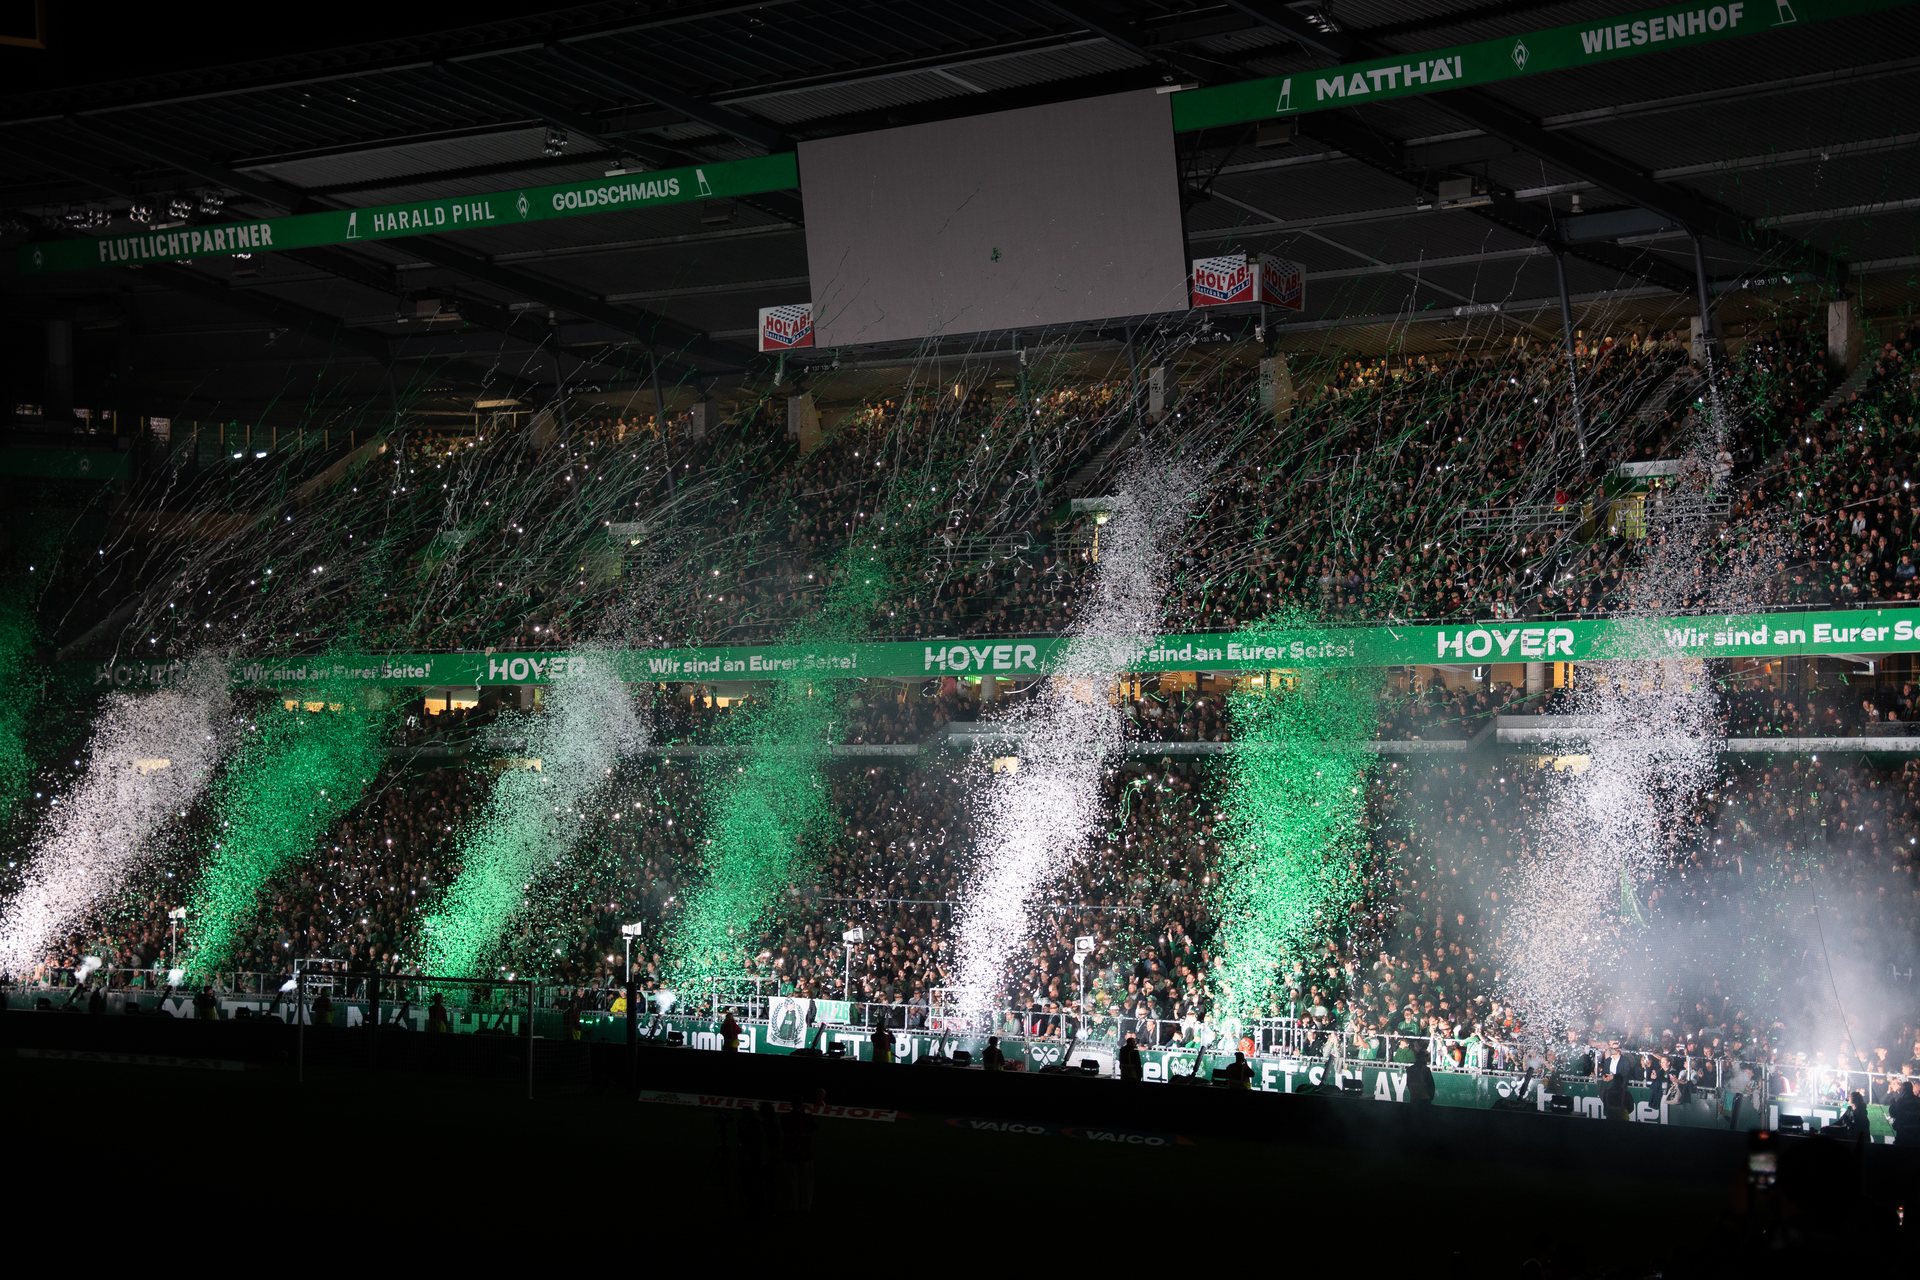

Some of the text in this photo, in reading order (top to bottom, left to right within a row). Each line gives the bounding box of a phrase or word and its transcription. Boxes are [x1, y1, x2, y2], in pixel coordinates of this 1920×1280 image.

[1579, 2, 1745, 55] WIESENHOF
[1314, 54, 1463, 101] MATTHÄI
[552, 177, 680, 211] GOLDSCHMAUS
[373, 201, 496, 233] HARALD PIHL
[98, 222, 273, 263] FLUTLICHTPARTNER
[1196, 264, 1249, 291] HOL'AB!
[766, 311, 811, 337] HOL'AB!
[1437, 628, 1575, 658] HOYER
[1663, 627, 1708, 647] Wir
[1713, 624, 1768, 646] sind
[1773, 627, 1806, 645] an
[1813, 623, 1890, 643] Eurer
[649, 657, 681, 674] Wir
[683, 656, 720, 673] sind
[723, 659, 745, 673] an
[750, 655, 800, 672] Eurer
[924, 644, 1037, 671] HOYER
[1150, 643, 1192, 662] sind
[1199, 648, 1222, 662] an
[1227, 643, 1286, 661] Eurer
[273, 665, 307, 681] sind
[697, 1095, 892, 1120] WIEENHOF
